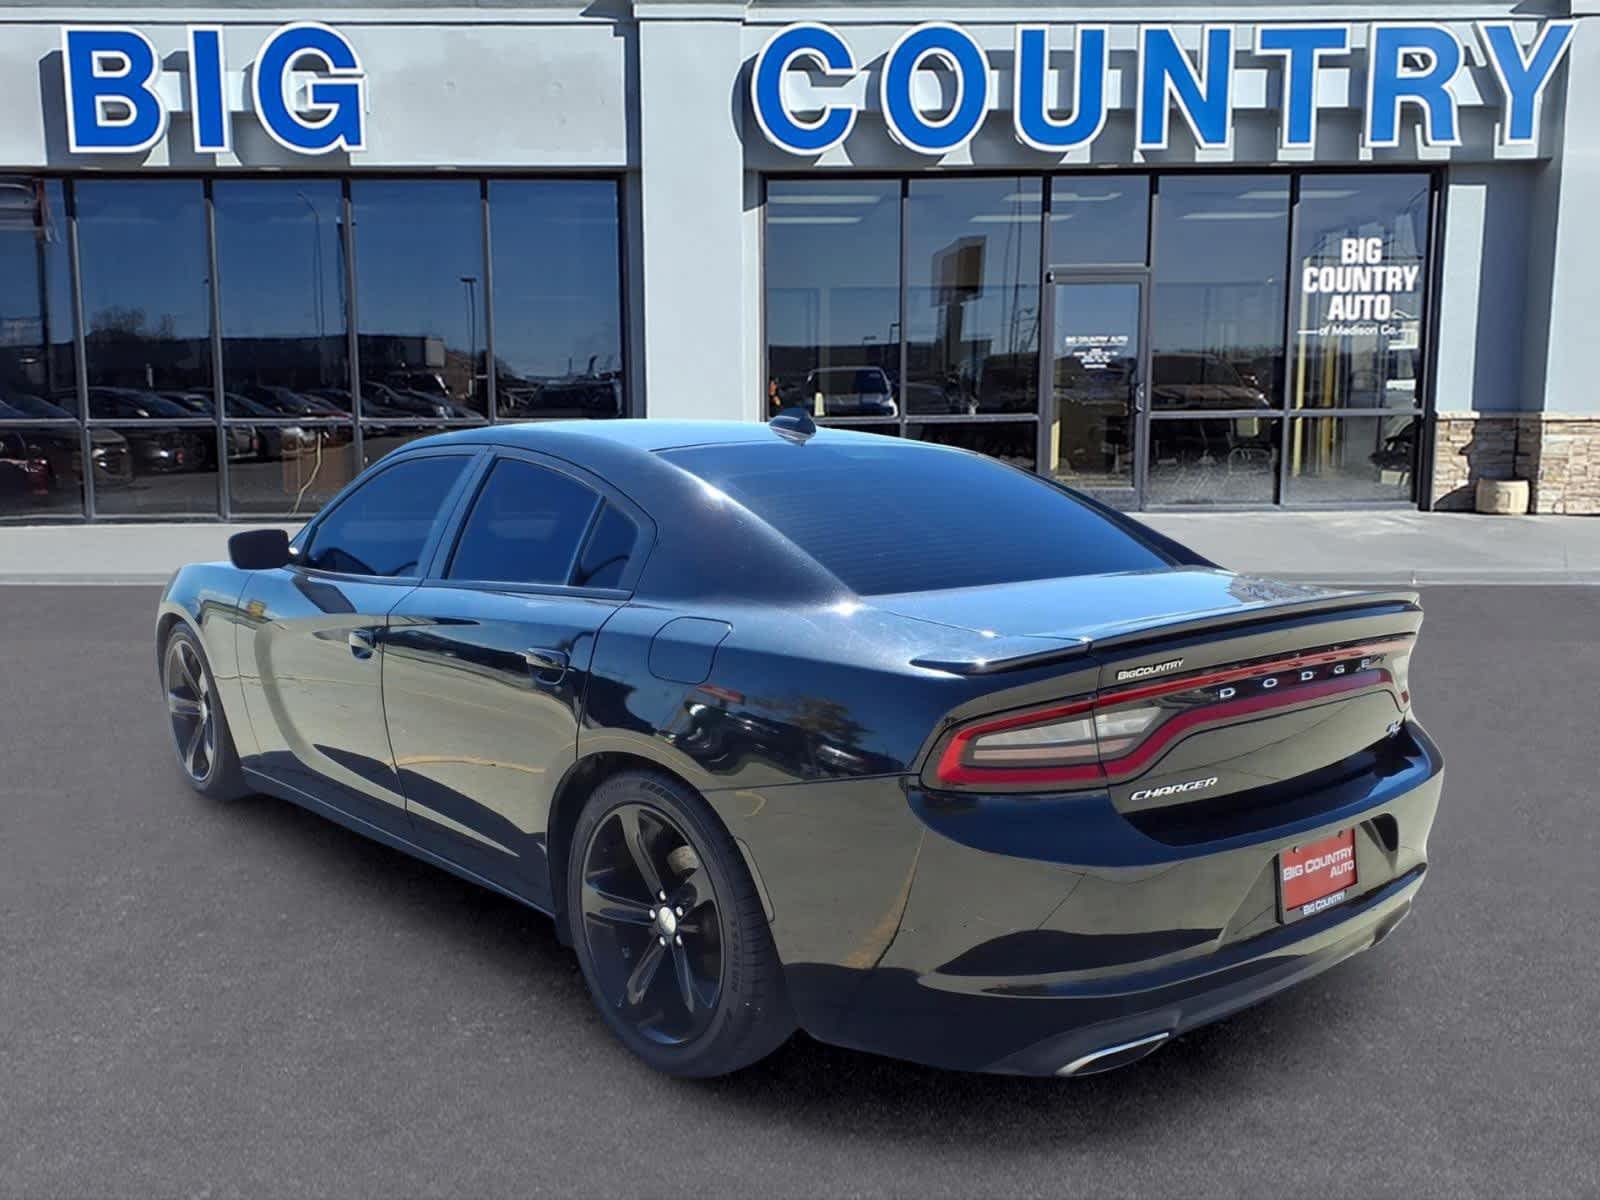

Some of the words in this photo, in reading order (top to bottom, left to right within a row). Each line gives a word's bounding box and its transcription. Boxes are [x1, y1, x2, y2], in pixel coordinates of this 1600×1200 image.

[61, 21, 368, 154] BIG
[750, 20, 1575, 157] COUNTRY
[1341, 237, 1382, 264] BIG
[1302, 265, 1420, 293] COUNTRY
[1327, 293, 1392, 321] AUTO
[1319, 323, 1330, 336] of
[1330, 322, 1378, 336] Madison
[1219, 658, 1371, 699] DODGE
[1131, 776, 1219, 801] CHARGER
[1283, 865, 1303, 881] BIG
[1305, 846, 1353, 873] COUNTRY
[1330, 860, 1354, 878] AUTO
[1303, 904, 1315, 915] BIG
[1315, 892, 1345, 910] COUNTRY
